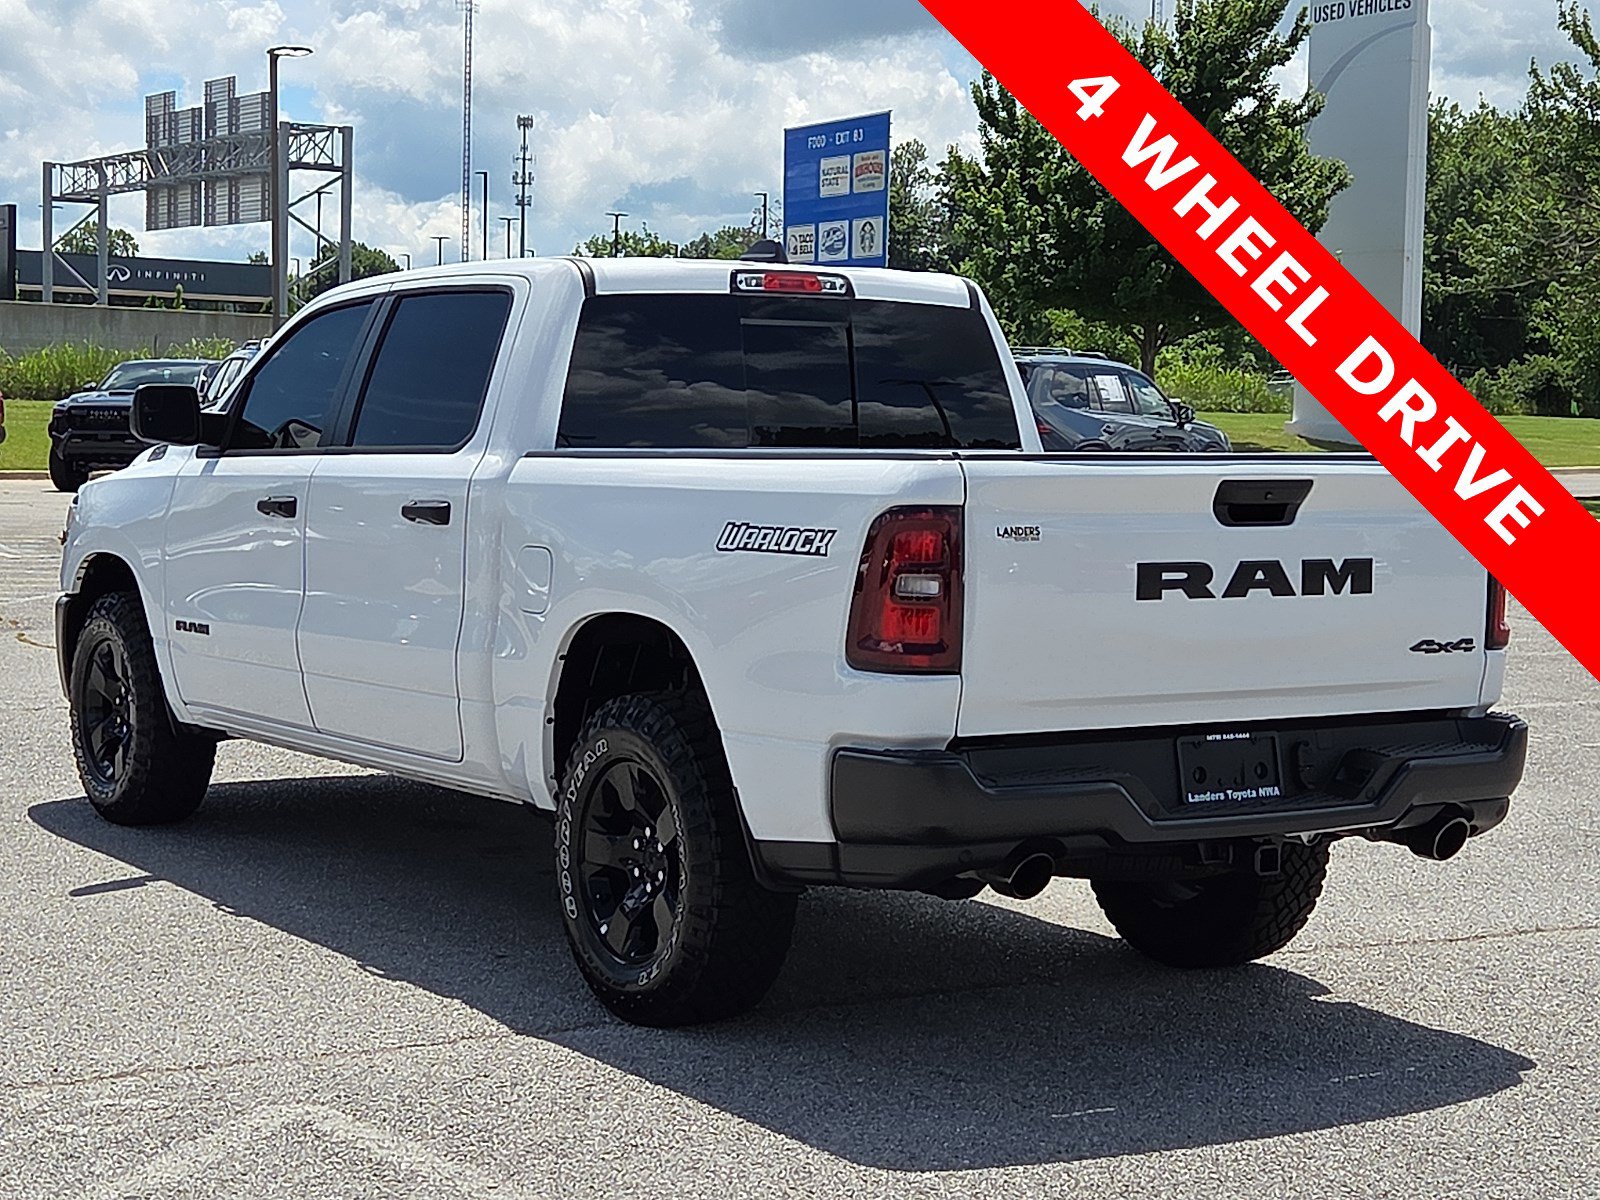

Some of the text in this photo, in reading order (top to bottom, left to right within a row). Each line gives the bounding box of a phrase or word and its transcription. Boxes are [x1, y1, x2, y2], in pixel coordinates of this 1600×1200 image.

[1314, 0, 1411, 23] USED VEHICLES
[808, 134, 826, 149] FOOD
[835, 130, 850, 145] EXIT
[821, 165, 849, 177] NATURAL
[821, 177, 840, 188] STATE
[798, 233, 814, 243] TACO
[798, 244, 814, 255] BELL
[136, 269, 206, 283] INFINITI
[715, 521, 837, 557] WARLOCK
[996, 526, 1041, 538] LANDERS
[1136, 557, 1374, 601] RAM
[175, 620, 210, 636] RAM
[1409, 637, 1476, 655] 4x4
[1188, 786, 1281, 803] Landers Toyota NWA
[560, 738, 609, 919] GOODYEAR
